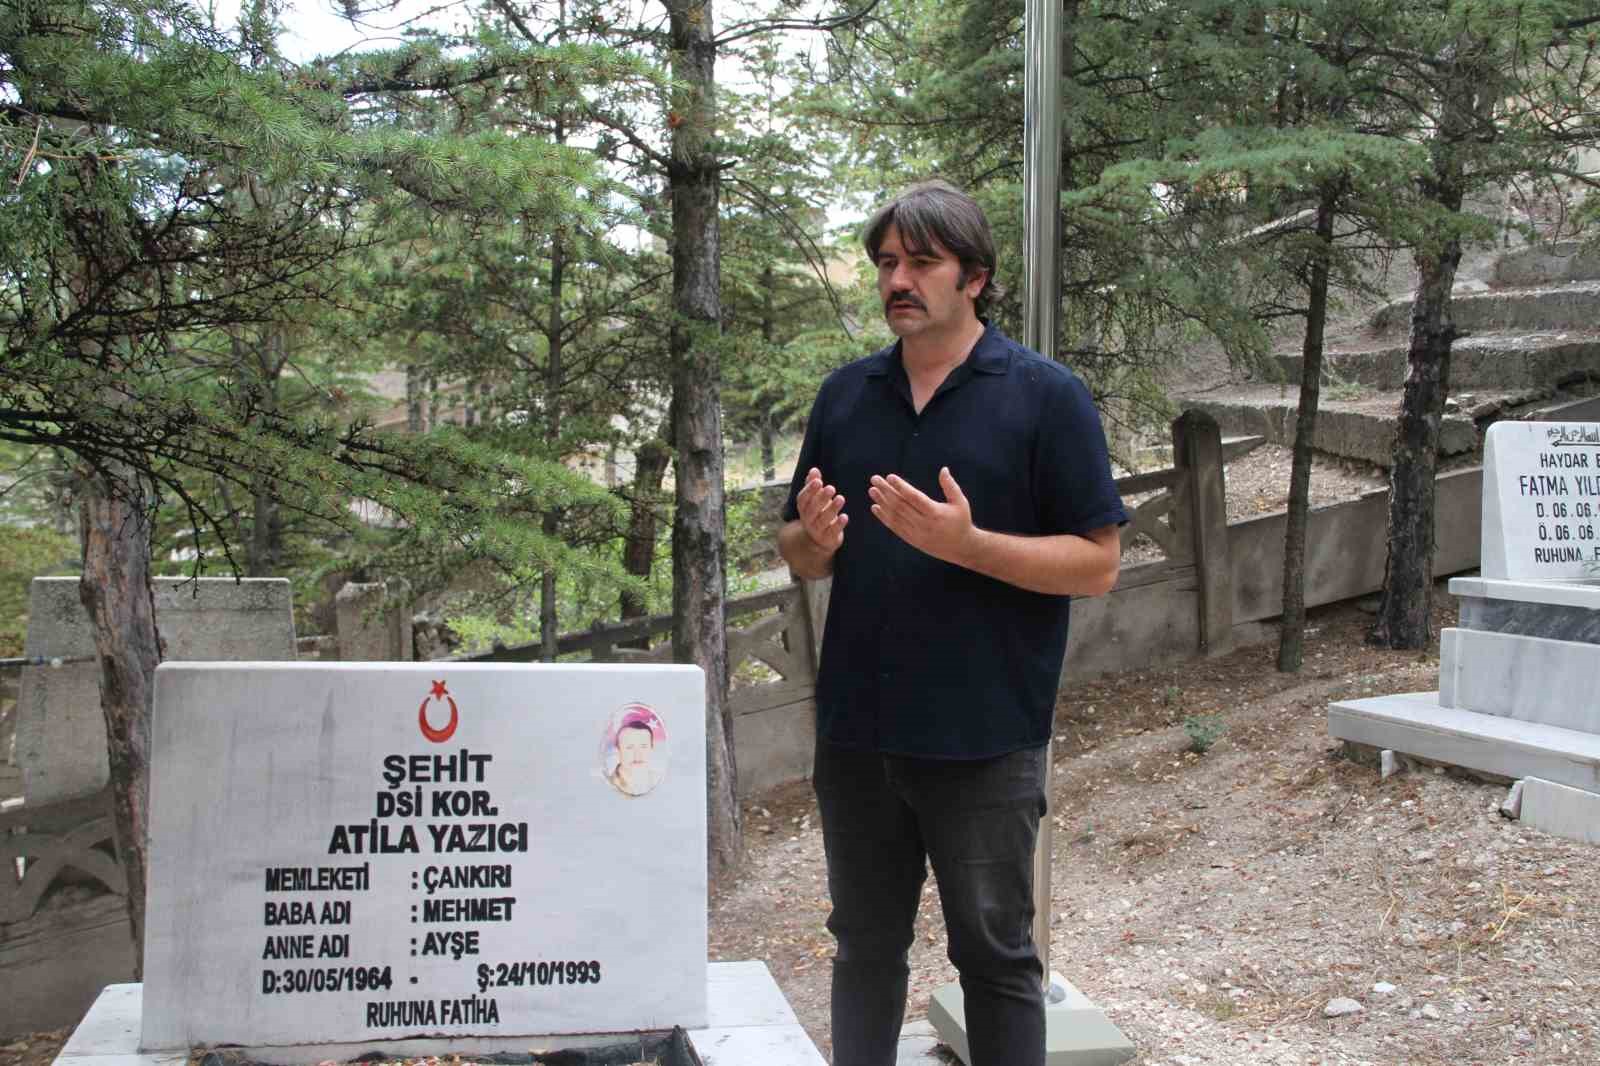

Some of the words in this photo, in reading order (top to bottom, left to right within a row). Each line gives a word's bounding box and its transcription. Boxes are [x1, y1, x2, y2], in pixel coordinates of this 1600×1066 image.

[1540, 453, 1588, 468] HAYDAR
[1520, 476, 1568, 496] FATMA
[1535, 547, 1583, 563] RUHUNA
[383, 749, 492, 790] ŞEHİT
[377, 784, 422, 818] DSİ
[432, 791, 498, 817] KOR.
[328, 816, 420, 854] ATİLA
[427, 823, 528, 853] YAZICI
[265, 862, 369, 892] MEMLEKETİ
[264, 902, 316, 926] BABA
[320, 901, 351, 924] ADI
[262, 935, 314, 960] ANNE
[318, 934, 349, 958] ADI
[262, 966, 392, 994] D:30/05/1964
[477, 961, 600, 993] Ş:24/10/1993
[367, 1000, 437, 1027] RUHUNA
[441, 992, 499, 1025] FATİHA
